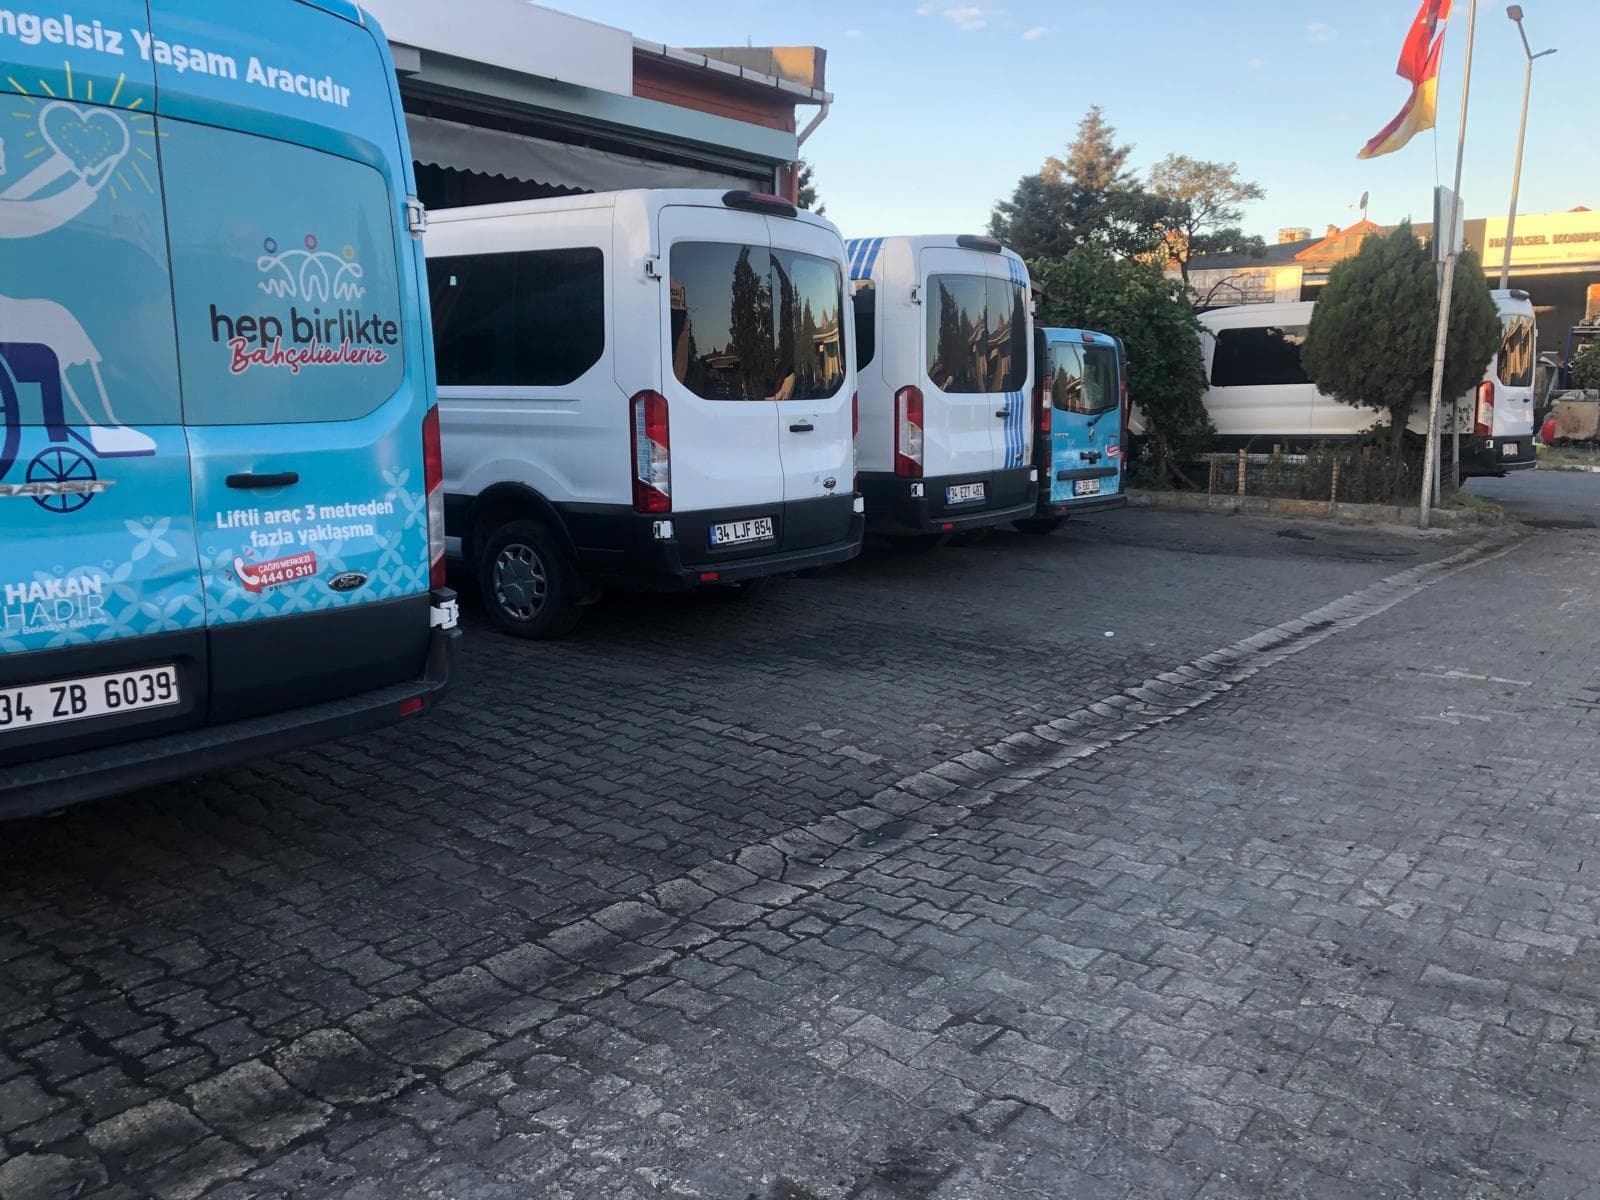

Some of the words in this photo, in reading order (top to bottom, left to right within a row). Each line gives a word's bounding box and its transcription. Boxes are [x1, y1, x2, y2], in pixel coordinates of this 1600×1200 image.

[130, 28, 238, 80] Yaşam
[245, 56, 351, 108] Aracıdır
[209, 303, 283, 348] hep
[290, 306, 398, 345] birlikte
[950, 487, 958, 500] 34
[216, 508, 260, 529] Liftli
[264, 508, 301, 525] araç
[305, 504, 316, 521] 3
[319, 500, 394, 519] metreden
[250, 528, 295, 548] fazla
[299, 522, 374, 546] yaklaşma
[717, 525, 730, 541] 34
[733, 522, 751, 539] LJF
[754, 519, 771, 536] 854
[260, 570, 284, 584] 444
[286, 568, 294, 579] 0
[295, 563, 313, 577] 311
[4, 574, 102, 605] HAKAN
[0, 691, 33, 725] 34
[50, 684, 87, 717] ZB
[104, 671, 172, 708] 6039
